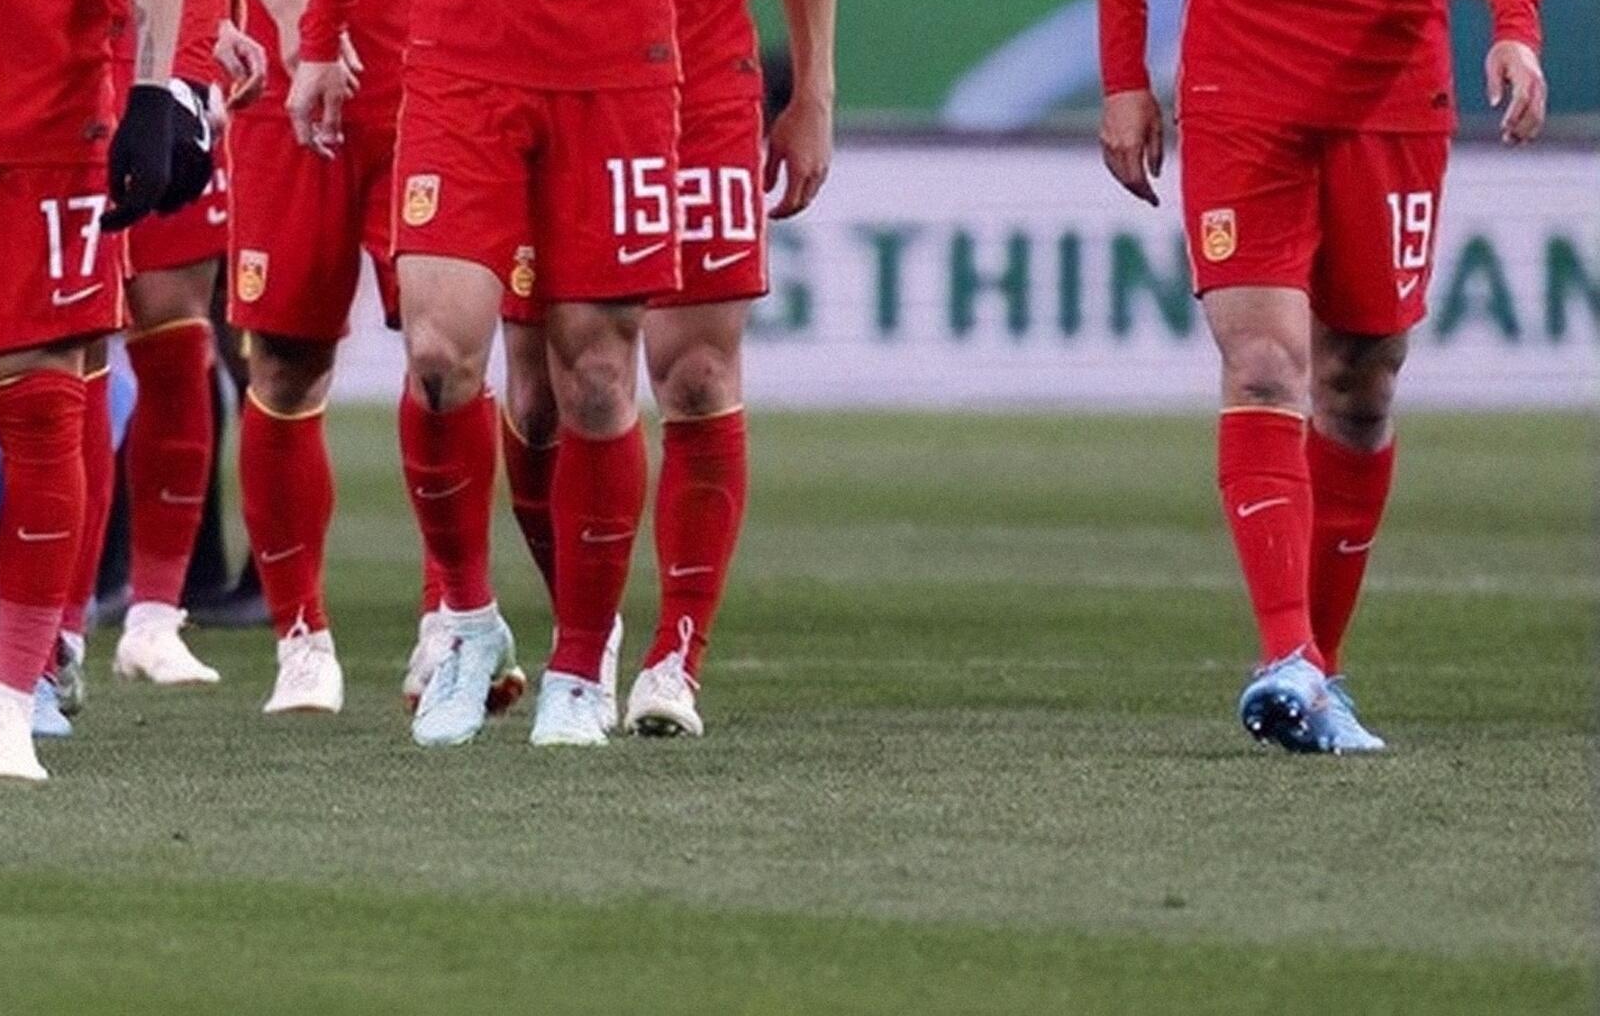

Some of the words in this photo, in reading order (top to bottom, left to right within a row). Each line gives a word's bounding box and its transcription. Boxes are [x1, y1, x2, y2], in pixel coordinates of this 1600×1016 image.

[607, 158, 669, 235] 15
[676, 168, 756, 241] 20
[1387, 192, 1432, 269] 19
[40, 195, 108, 279] 17
